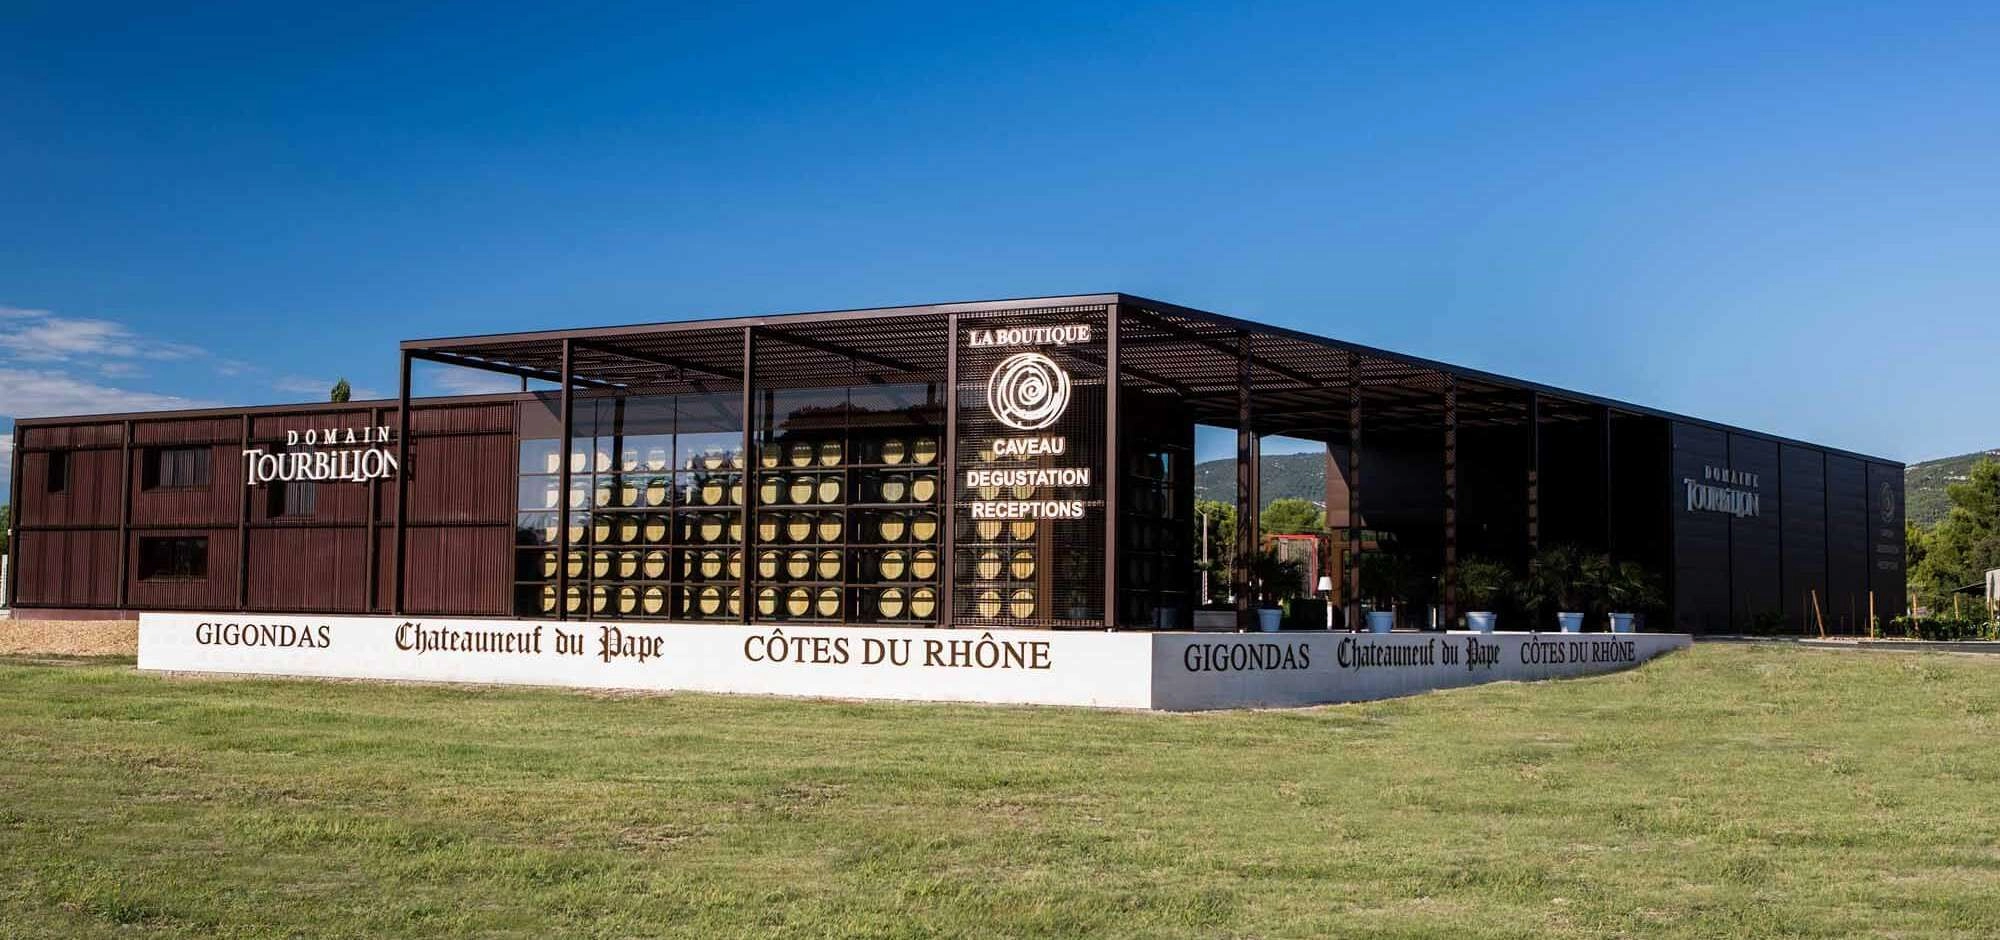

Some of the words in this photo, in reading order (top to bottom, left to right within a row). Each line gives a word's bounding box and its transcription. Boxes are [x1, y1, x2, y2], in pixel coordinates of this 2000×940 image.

[970, 330, 993, 347] LA
[999, 325, 1091, 346] BOUTIQUE
[287, 426, 390, 446] DOMAIN
[993, 437, 1065, 455] CAVEAU
[967, 468, 1090, 488] DEGUSTATION
[1705, 465, 1759, 487] DOMAINE
[972, 500, 1085, 519] RECEPTIONS
[195, 621, 331, 648] GIGONDAS
[395, 621, 542, 654] Chateauneuf
[555, 628, 584, 655] du
[598, 625, 665, 664] Pape
[743, 628, 850, 664] CÔTES
[861, 638, 910, 666] DU
[923, 633, 1052, 670] RHÔNE
[1184, 643, 1310, 672] GIGONDAS
[1337, 637, 1435, 671] Chateauneuf
[1441, 639, 1459, 666] du
[1465, 636, 1500, 672] Pape
[1520, 636, 1565, 665] CÔTES
[1568, 642, 1589, 664] DU
[1592, 636, 1635, 662] RHÔNE
